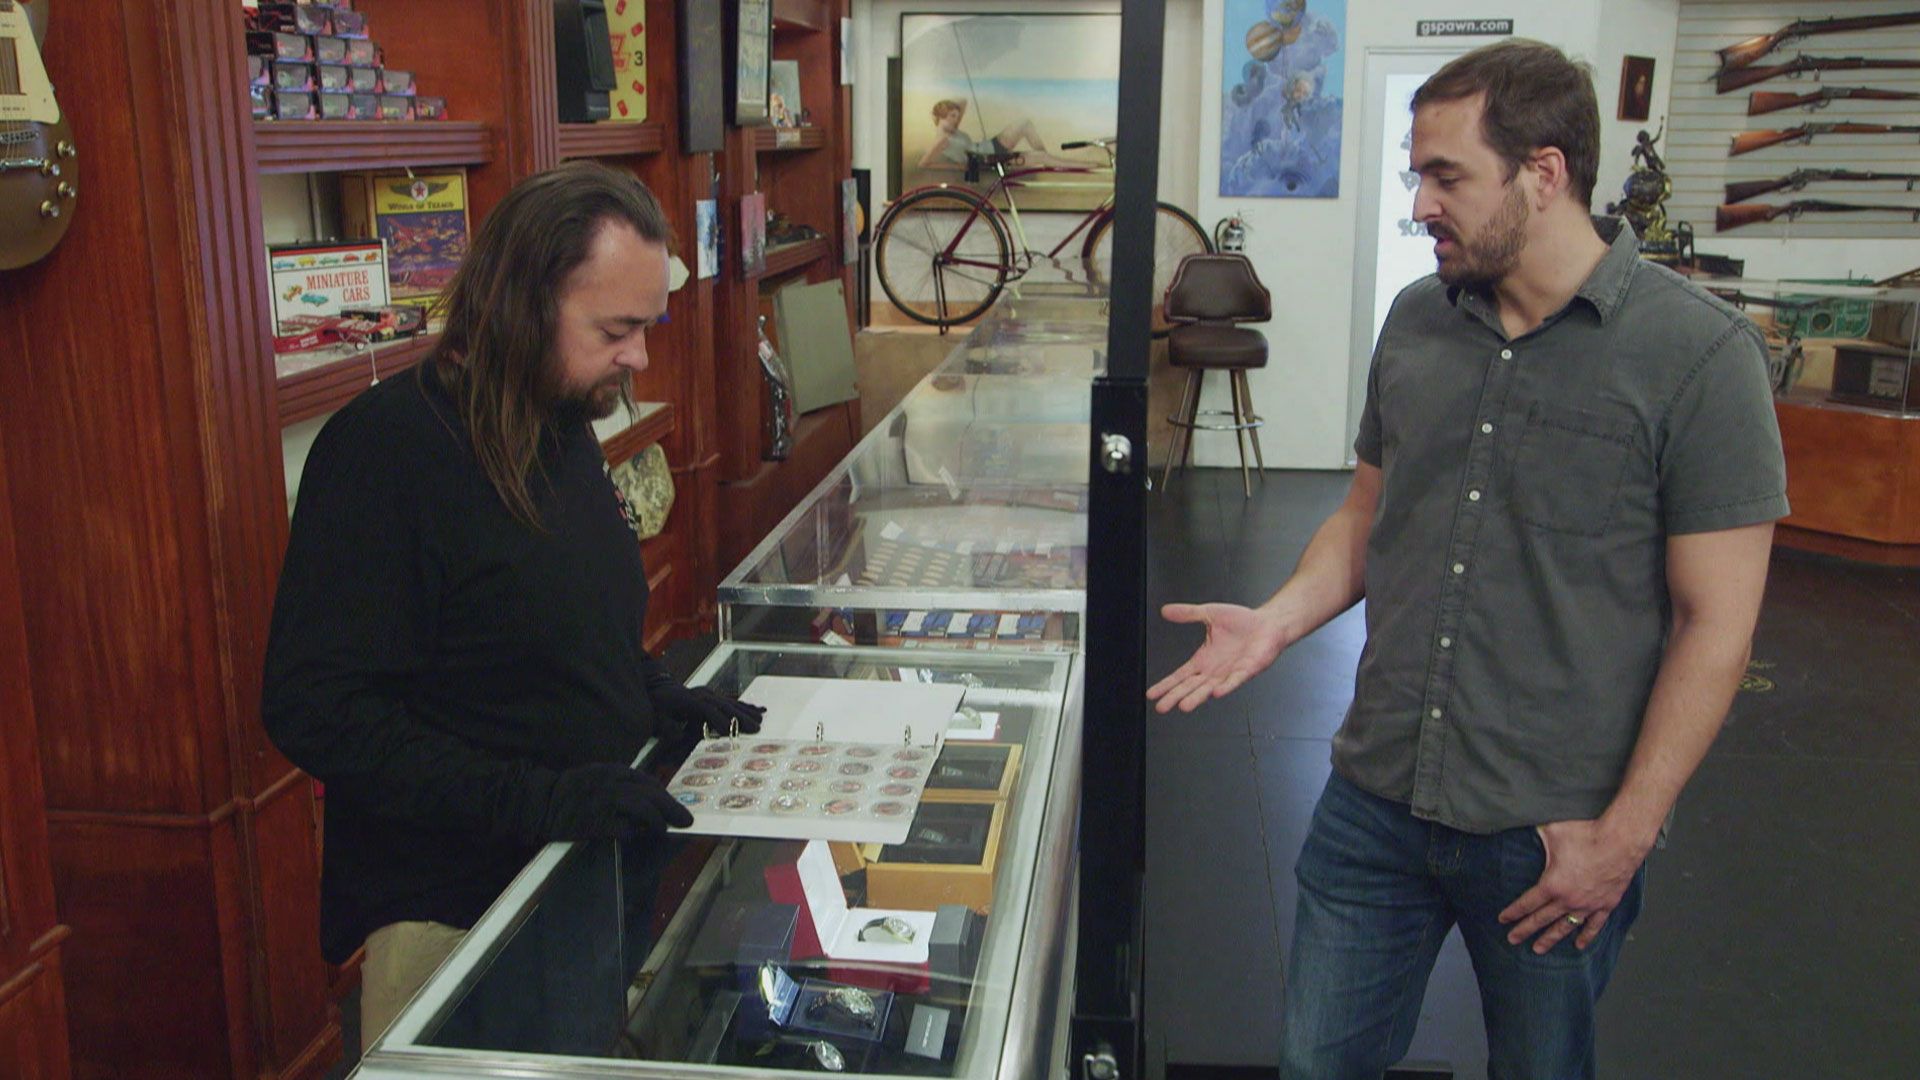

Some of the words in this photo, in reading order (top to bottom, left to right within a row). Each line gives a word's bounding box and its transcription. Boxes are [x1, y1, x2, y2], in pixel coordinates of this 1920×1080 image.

[1421, 21, 1509, 35] gspawn.com
[634, 50, 644, 67] 3
[306, 270, 369, 291] MINIATURE
[343, 287, 371, 303] CARS
